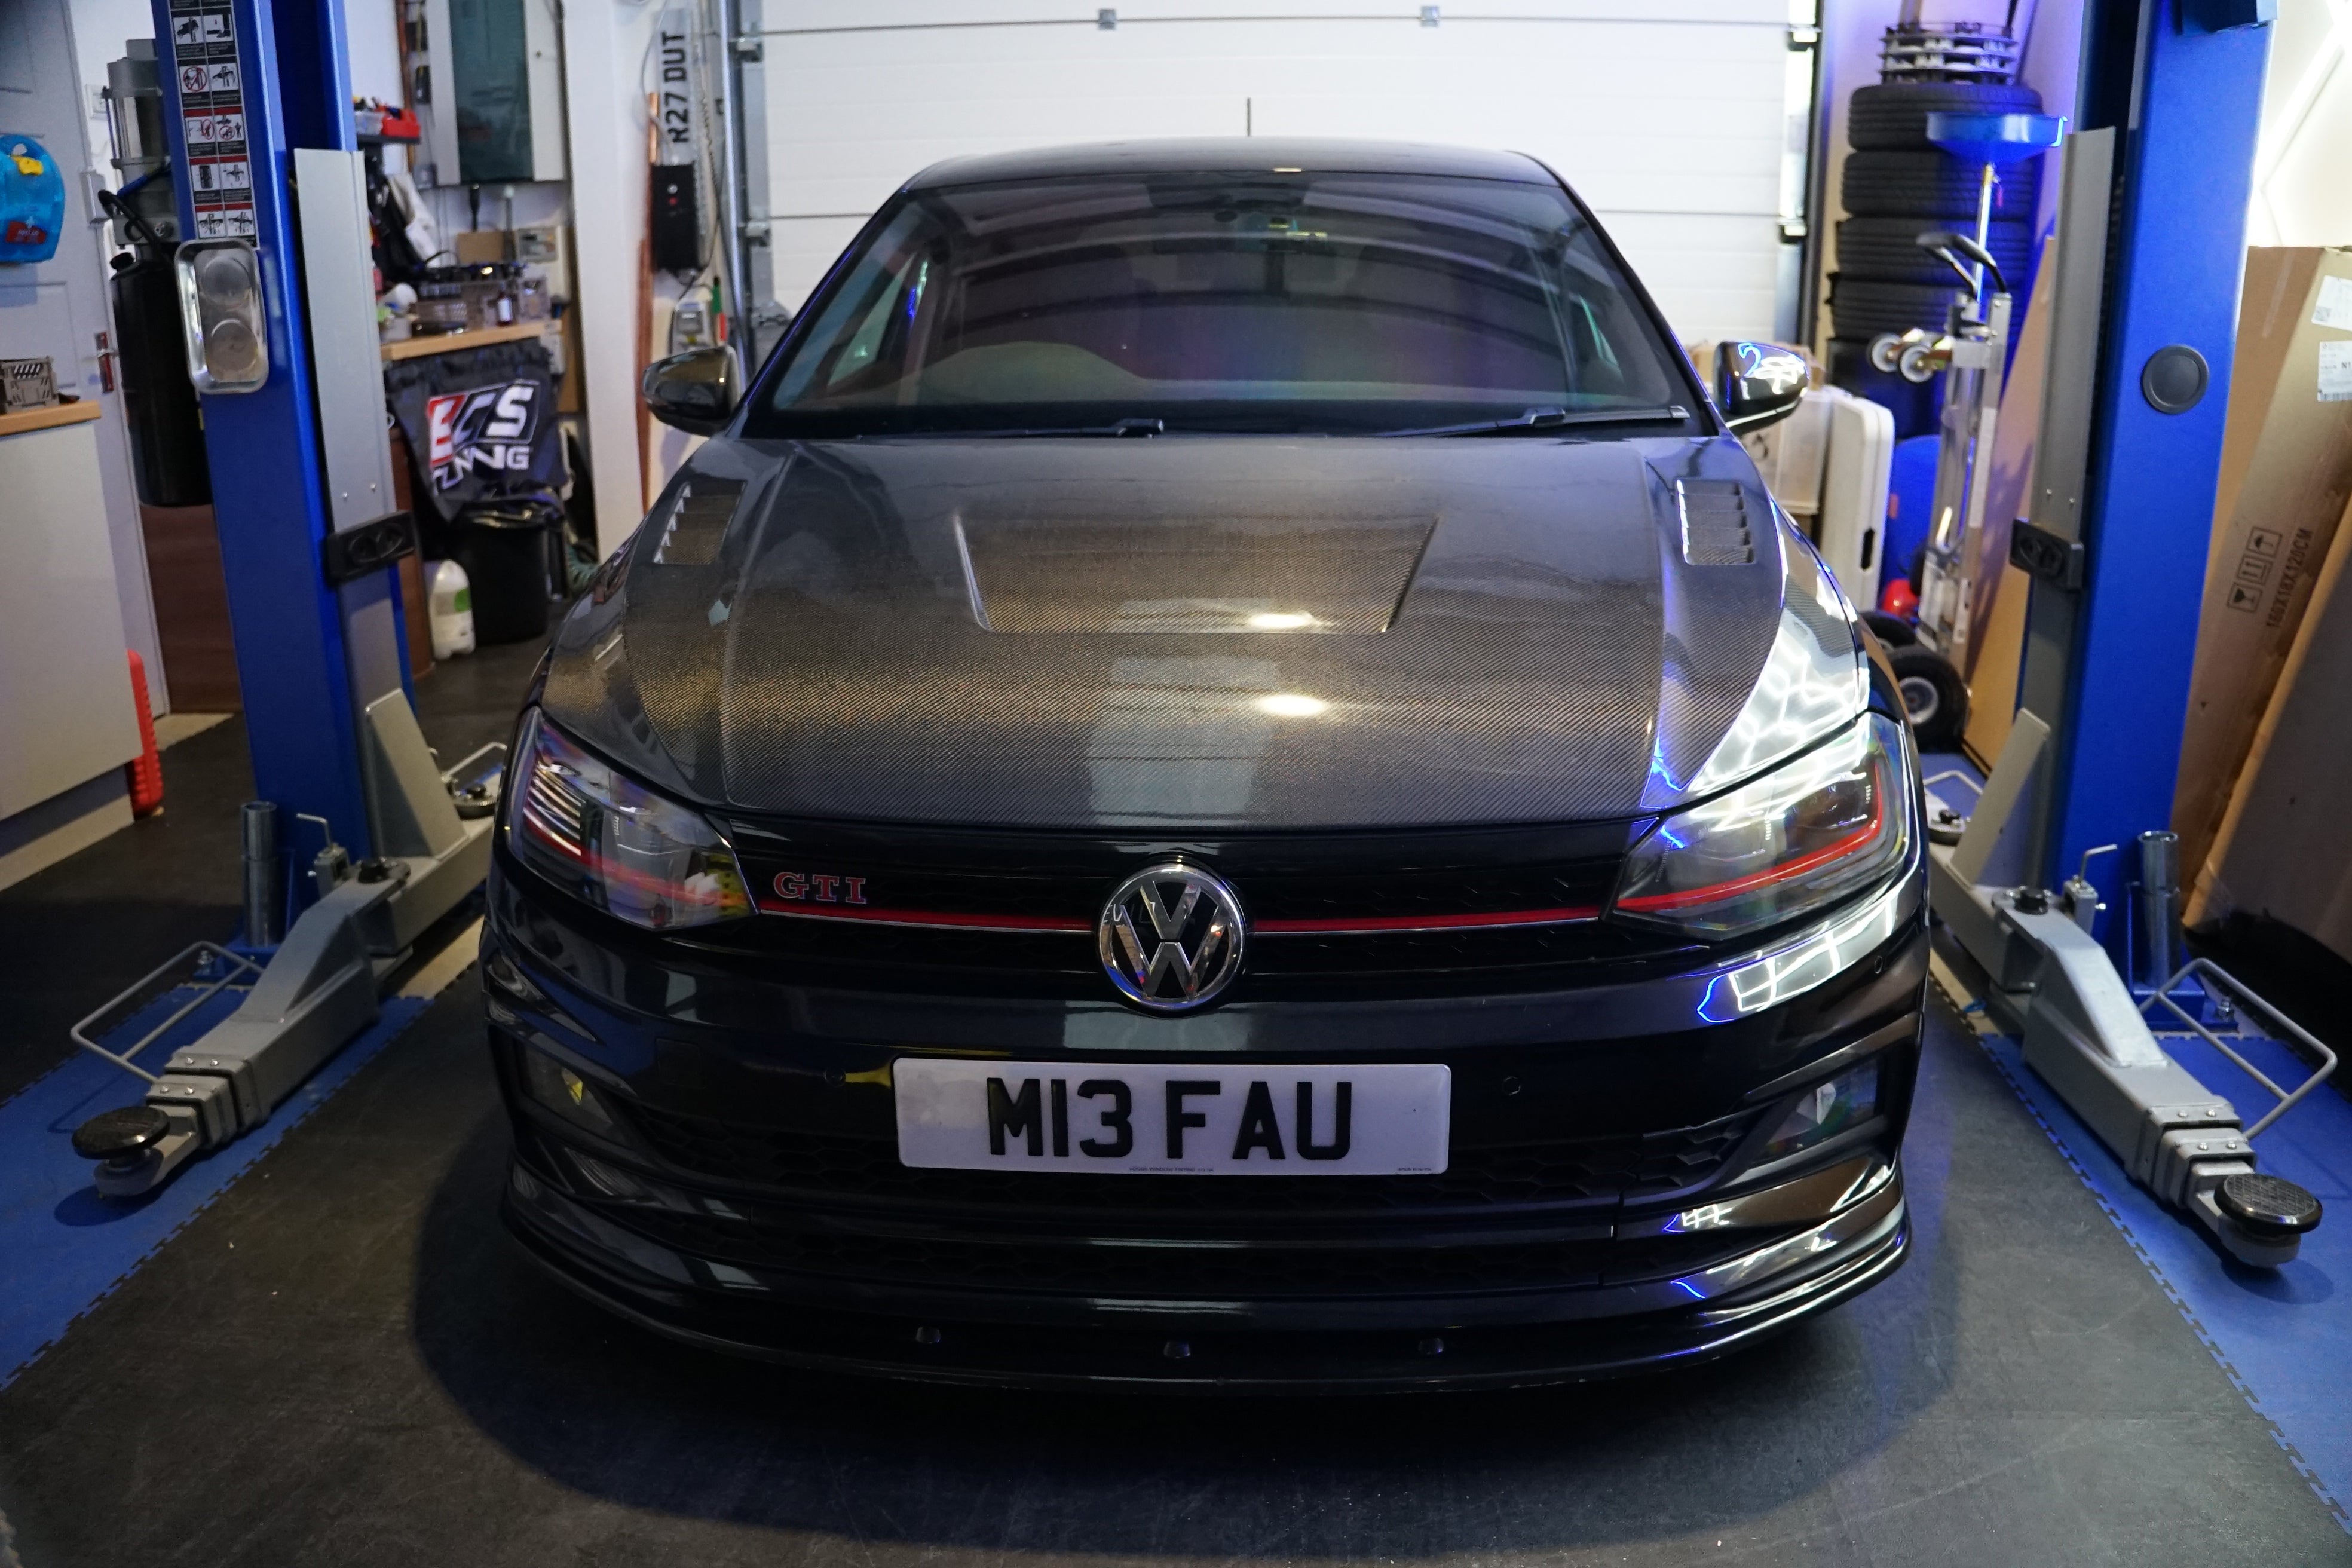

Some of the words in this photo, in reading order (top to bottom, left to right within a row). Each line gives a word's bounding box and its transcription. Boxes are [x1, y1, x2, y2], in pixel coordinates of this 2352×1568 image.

[662, 32, 687, 82] DUT
[665, 91, 689, 143] R27
[774, 872, 867, 904] GTI
[987, 1077, 1134, 1158] M13
[1165, 1080, 1352, 1160] FAU
